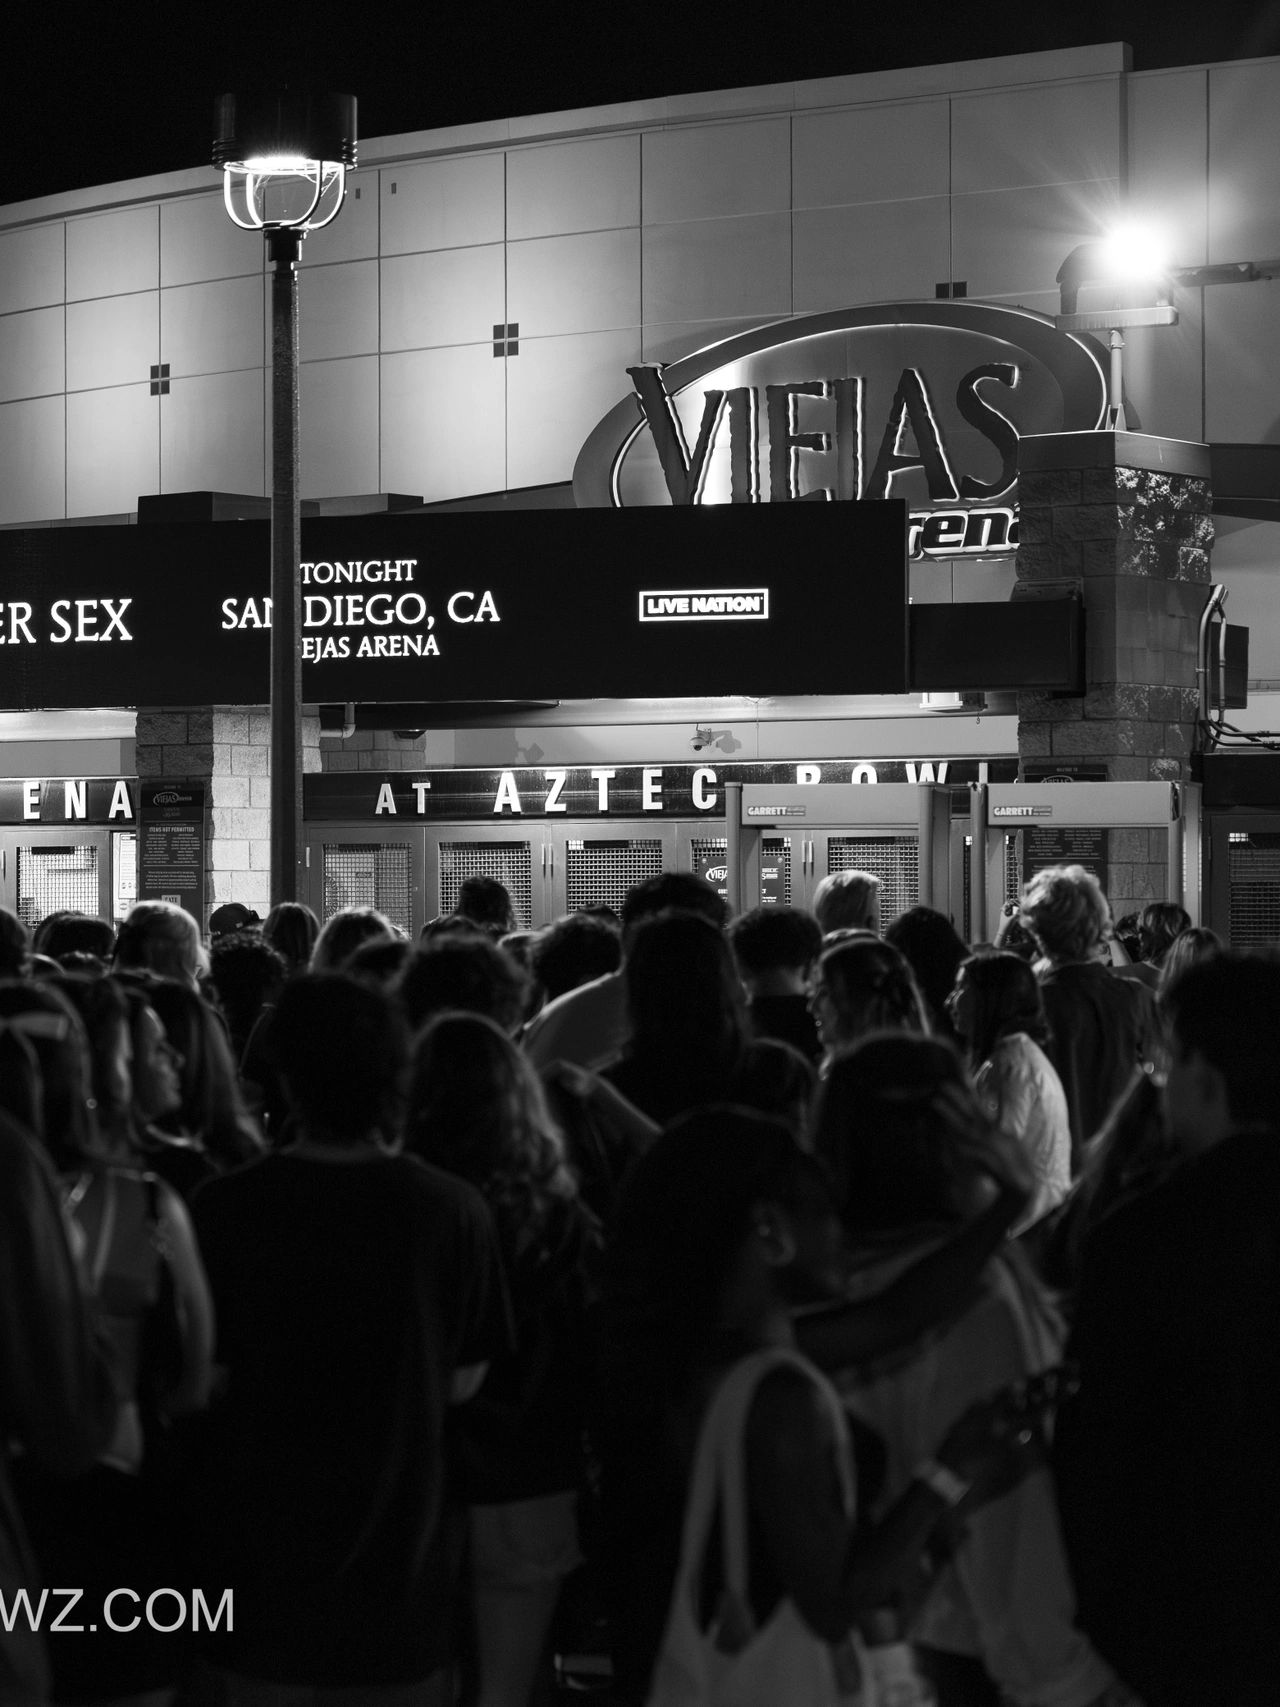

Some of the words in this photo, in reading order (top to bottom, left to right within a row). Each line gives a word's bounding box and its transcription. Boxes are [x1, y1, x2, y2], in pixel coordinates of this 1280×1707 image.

[299, 559, 418, 584] TONIGHT
[303, 592, 436, 631] DIEGO,
[447, 590, 501, 624] CA
[647, 597, 690, 614] LIVE
[691, 596, 761, 613] NATION
[49, 597, 134, 643] SEX
[301, 635, 351, 664] EJAS
[356, 633, 440, 659] ARENA
[374, 782, 431, 815] AT
[493, 768, 718, 814] AZTEC
[748, 807, 787, 816] GARRETT
[994, 807, 1033, 816] GARRETT
